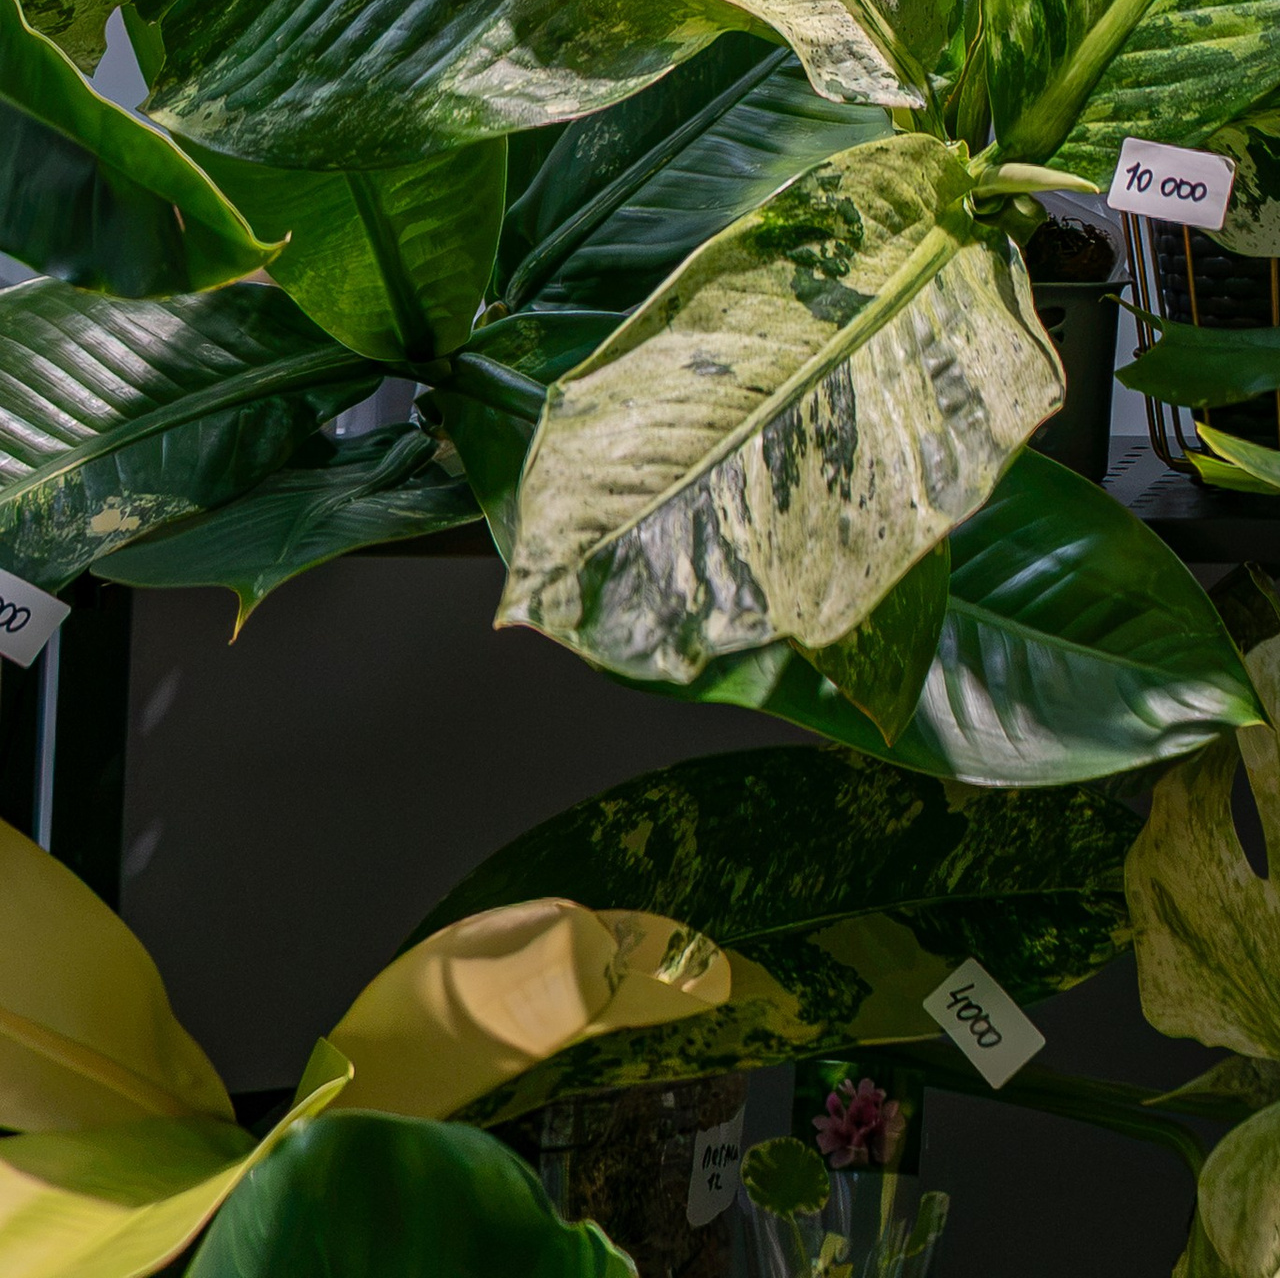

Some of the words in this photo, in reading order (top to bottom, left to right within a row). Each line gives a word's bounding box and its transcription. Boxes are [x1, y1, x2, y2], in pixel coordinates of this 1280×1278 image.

[1126, 162, 1153, 193] 10
[1161, 177, 1207, 202] 000
[0, 596, 31, 633] 00
[946, 983, 1002, 1048] 4000
